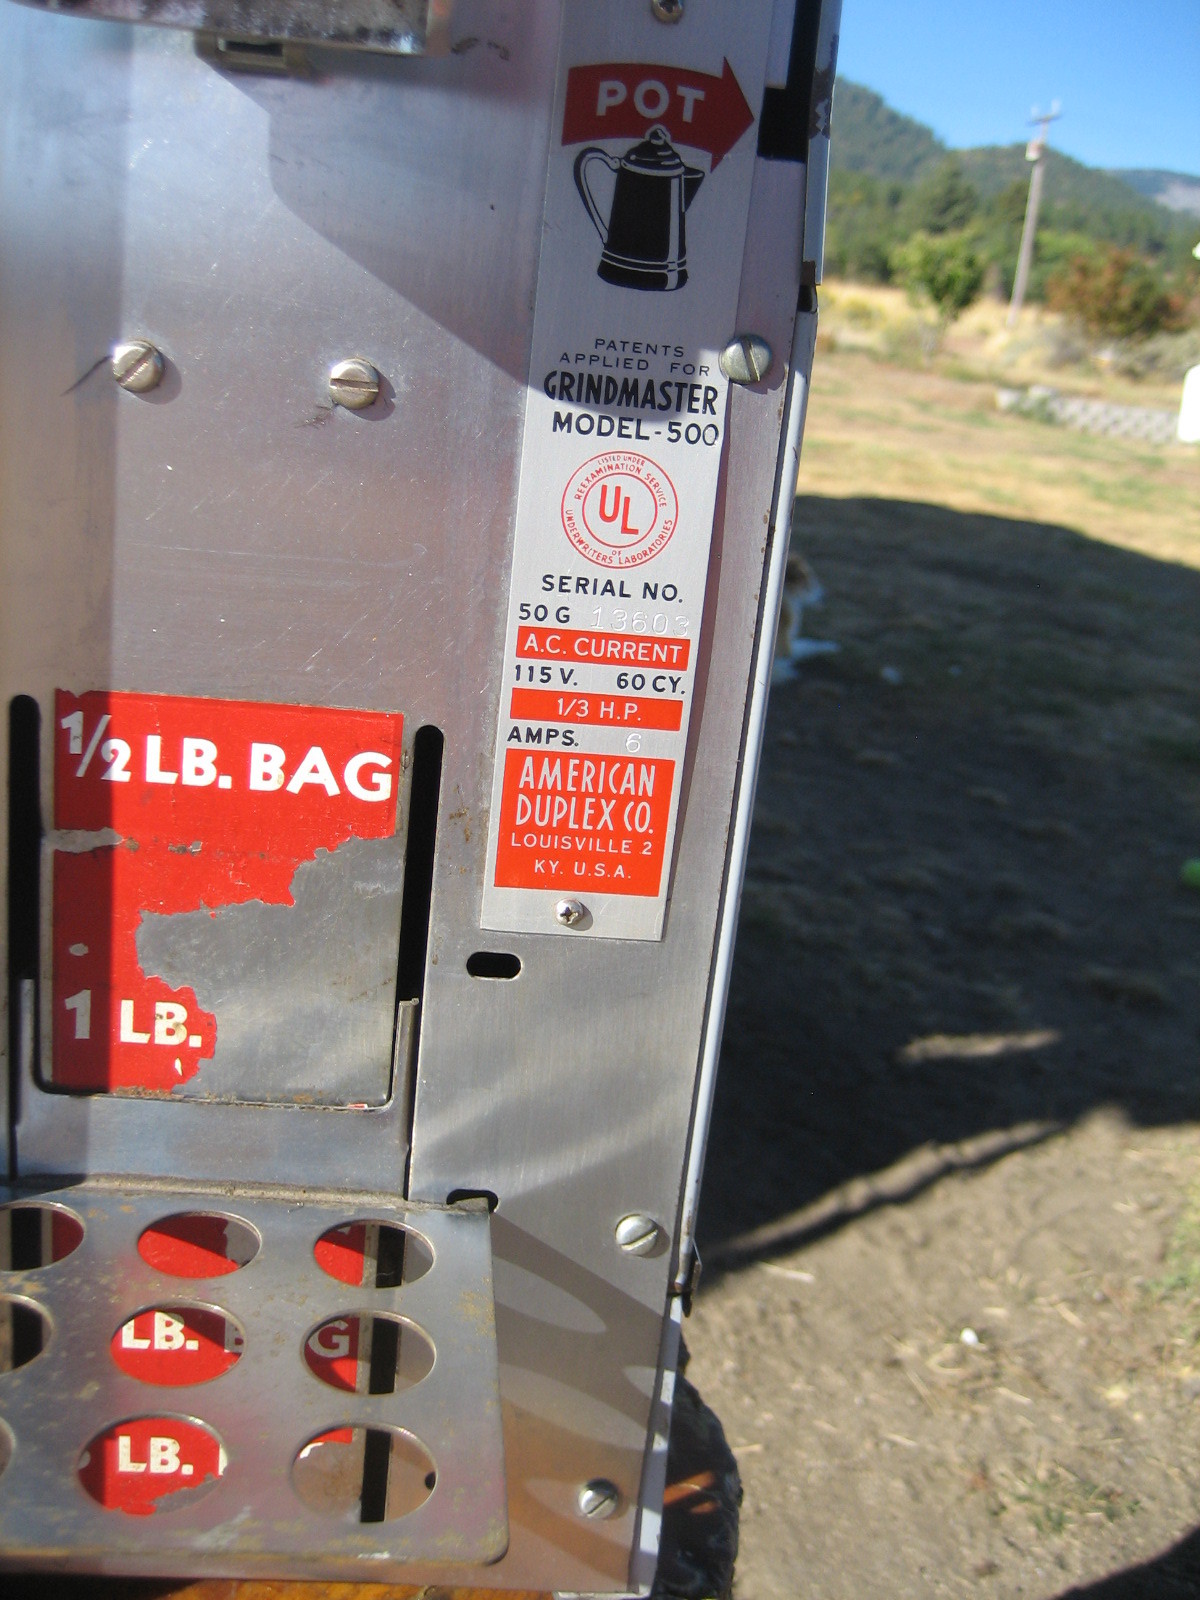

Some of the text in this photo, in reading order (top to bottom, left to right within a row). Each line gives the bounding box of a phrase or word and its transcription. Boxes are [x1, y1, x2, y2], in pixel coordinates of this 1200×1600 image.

[596, 80, 705, 123] POT
[559, 352, 710, 376] APPLIED FOR
[594, 339, 684, 358] PATENTS
[544, 370, 718, 415] GRINDMASTER
[597, 455, 646, 467] LISTED UNDER
[574, 463, 667, 508] REEXAMINATION SERVICE
[599, 484, 639, 535] UL
[565, 509, 673, 565] UNDERWRITERS LABORATORIES
[542, 574, 683, 603] SERIAL NO.
[590, 606, 690, 637] 13603
[523, 633, 683, 664] A.C. CURRENT
[557, 697, 642, 722] 1/3 H.P.
[507, 726, 642, 753] AMPS. 6
[145, 734, 233, 790] LB.
[249, 742, 393, 803] BAG
[518, 755, 656, 797] AMERICAN
[515, 793, 654, 834] DUPLEX CO.
[511, 832, 652, 856] LOUISVILLE 2
[534, 859, 632, 879] KY. U.S.A.
[64, 988, 202, 1048] 1 LB.
[121, 1310, 199, 1351] LB.
[118, 1435, 194, 1476] LB.
